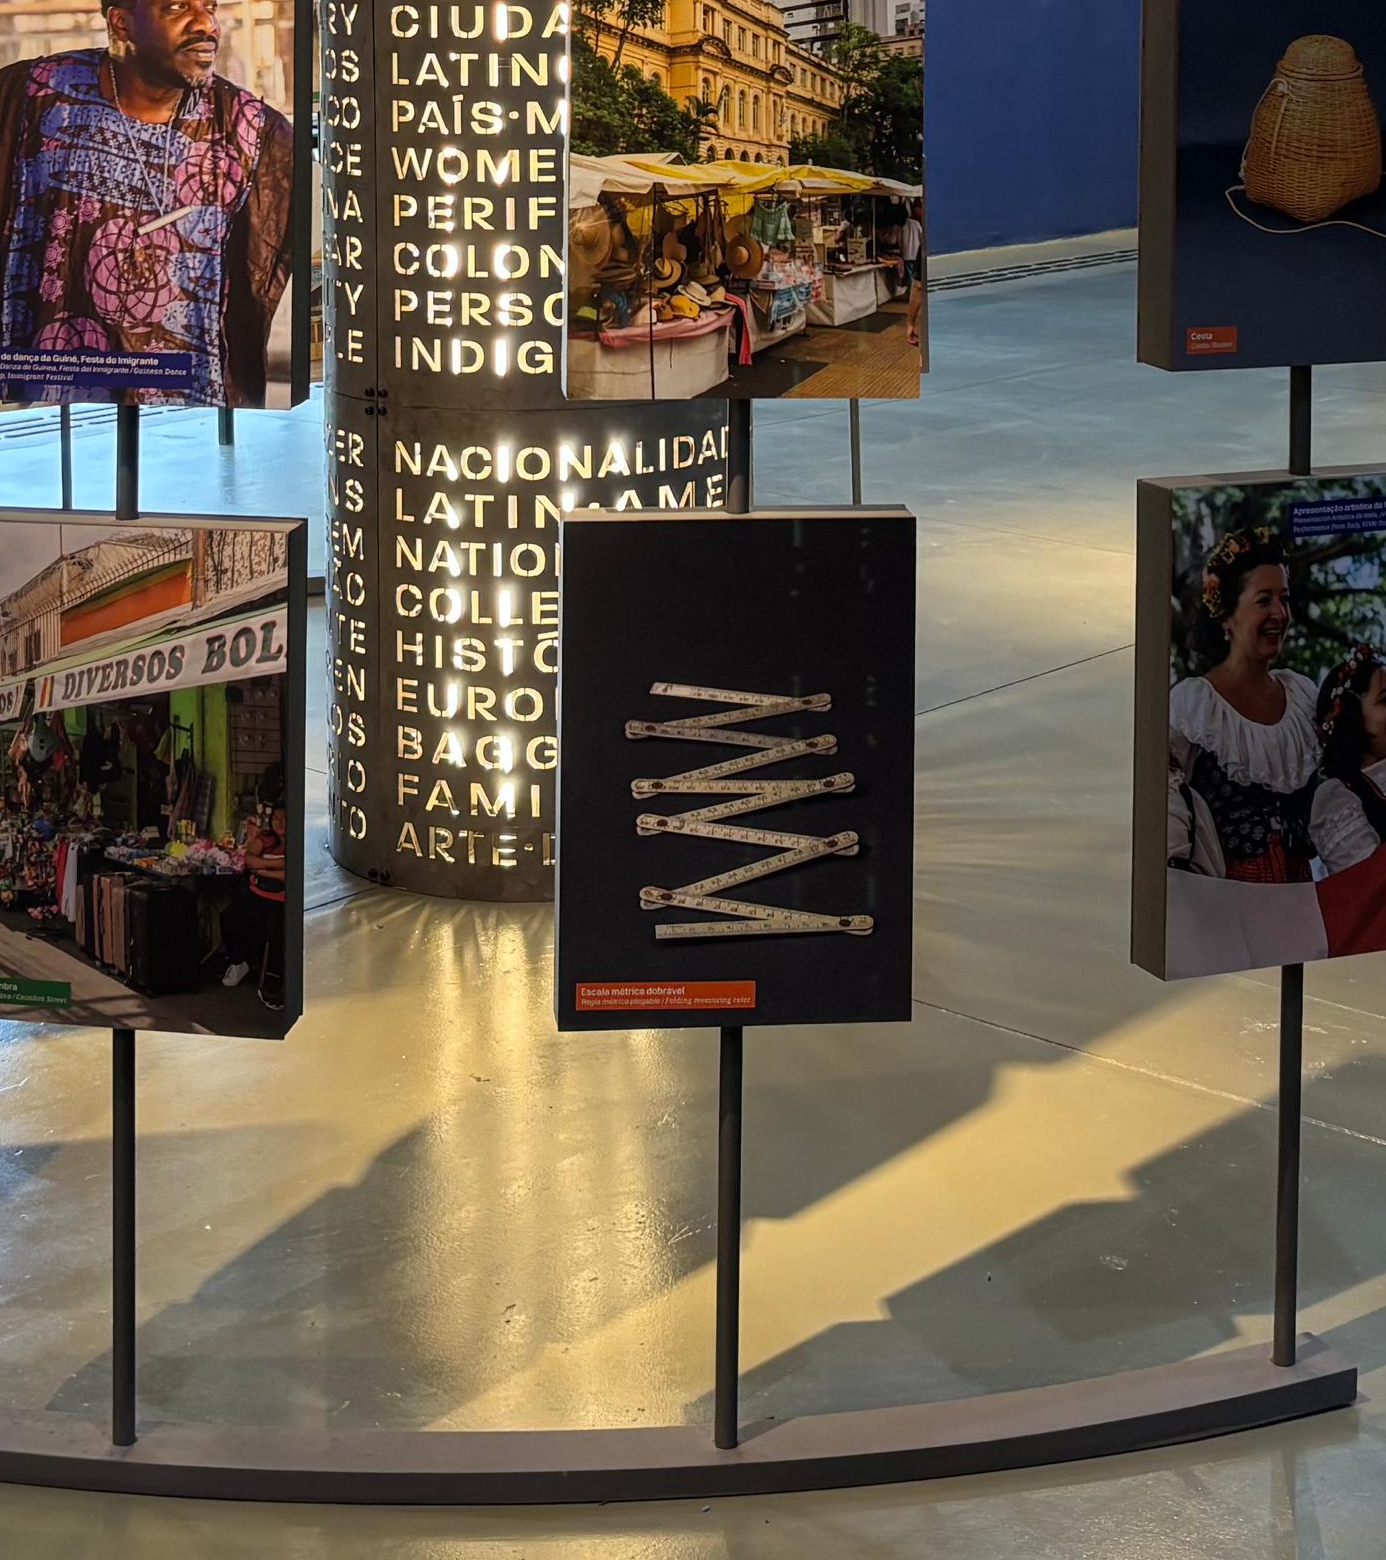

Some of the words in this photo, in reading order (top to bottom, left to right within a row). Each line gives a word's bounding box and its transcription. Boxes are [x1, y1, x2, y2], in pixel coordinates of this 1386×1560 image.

[62, 644, 185, 701] DIVERSOS
[201, 620, 285, 674] BOL
[581, 987, 610, 996] Escala
